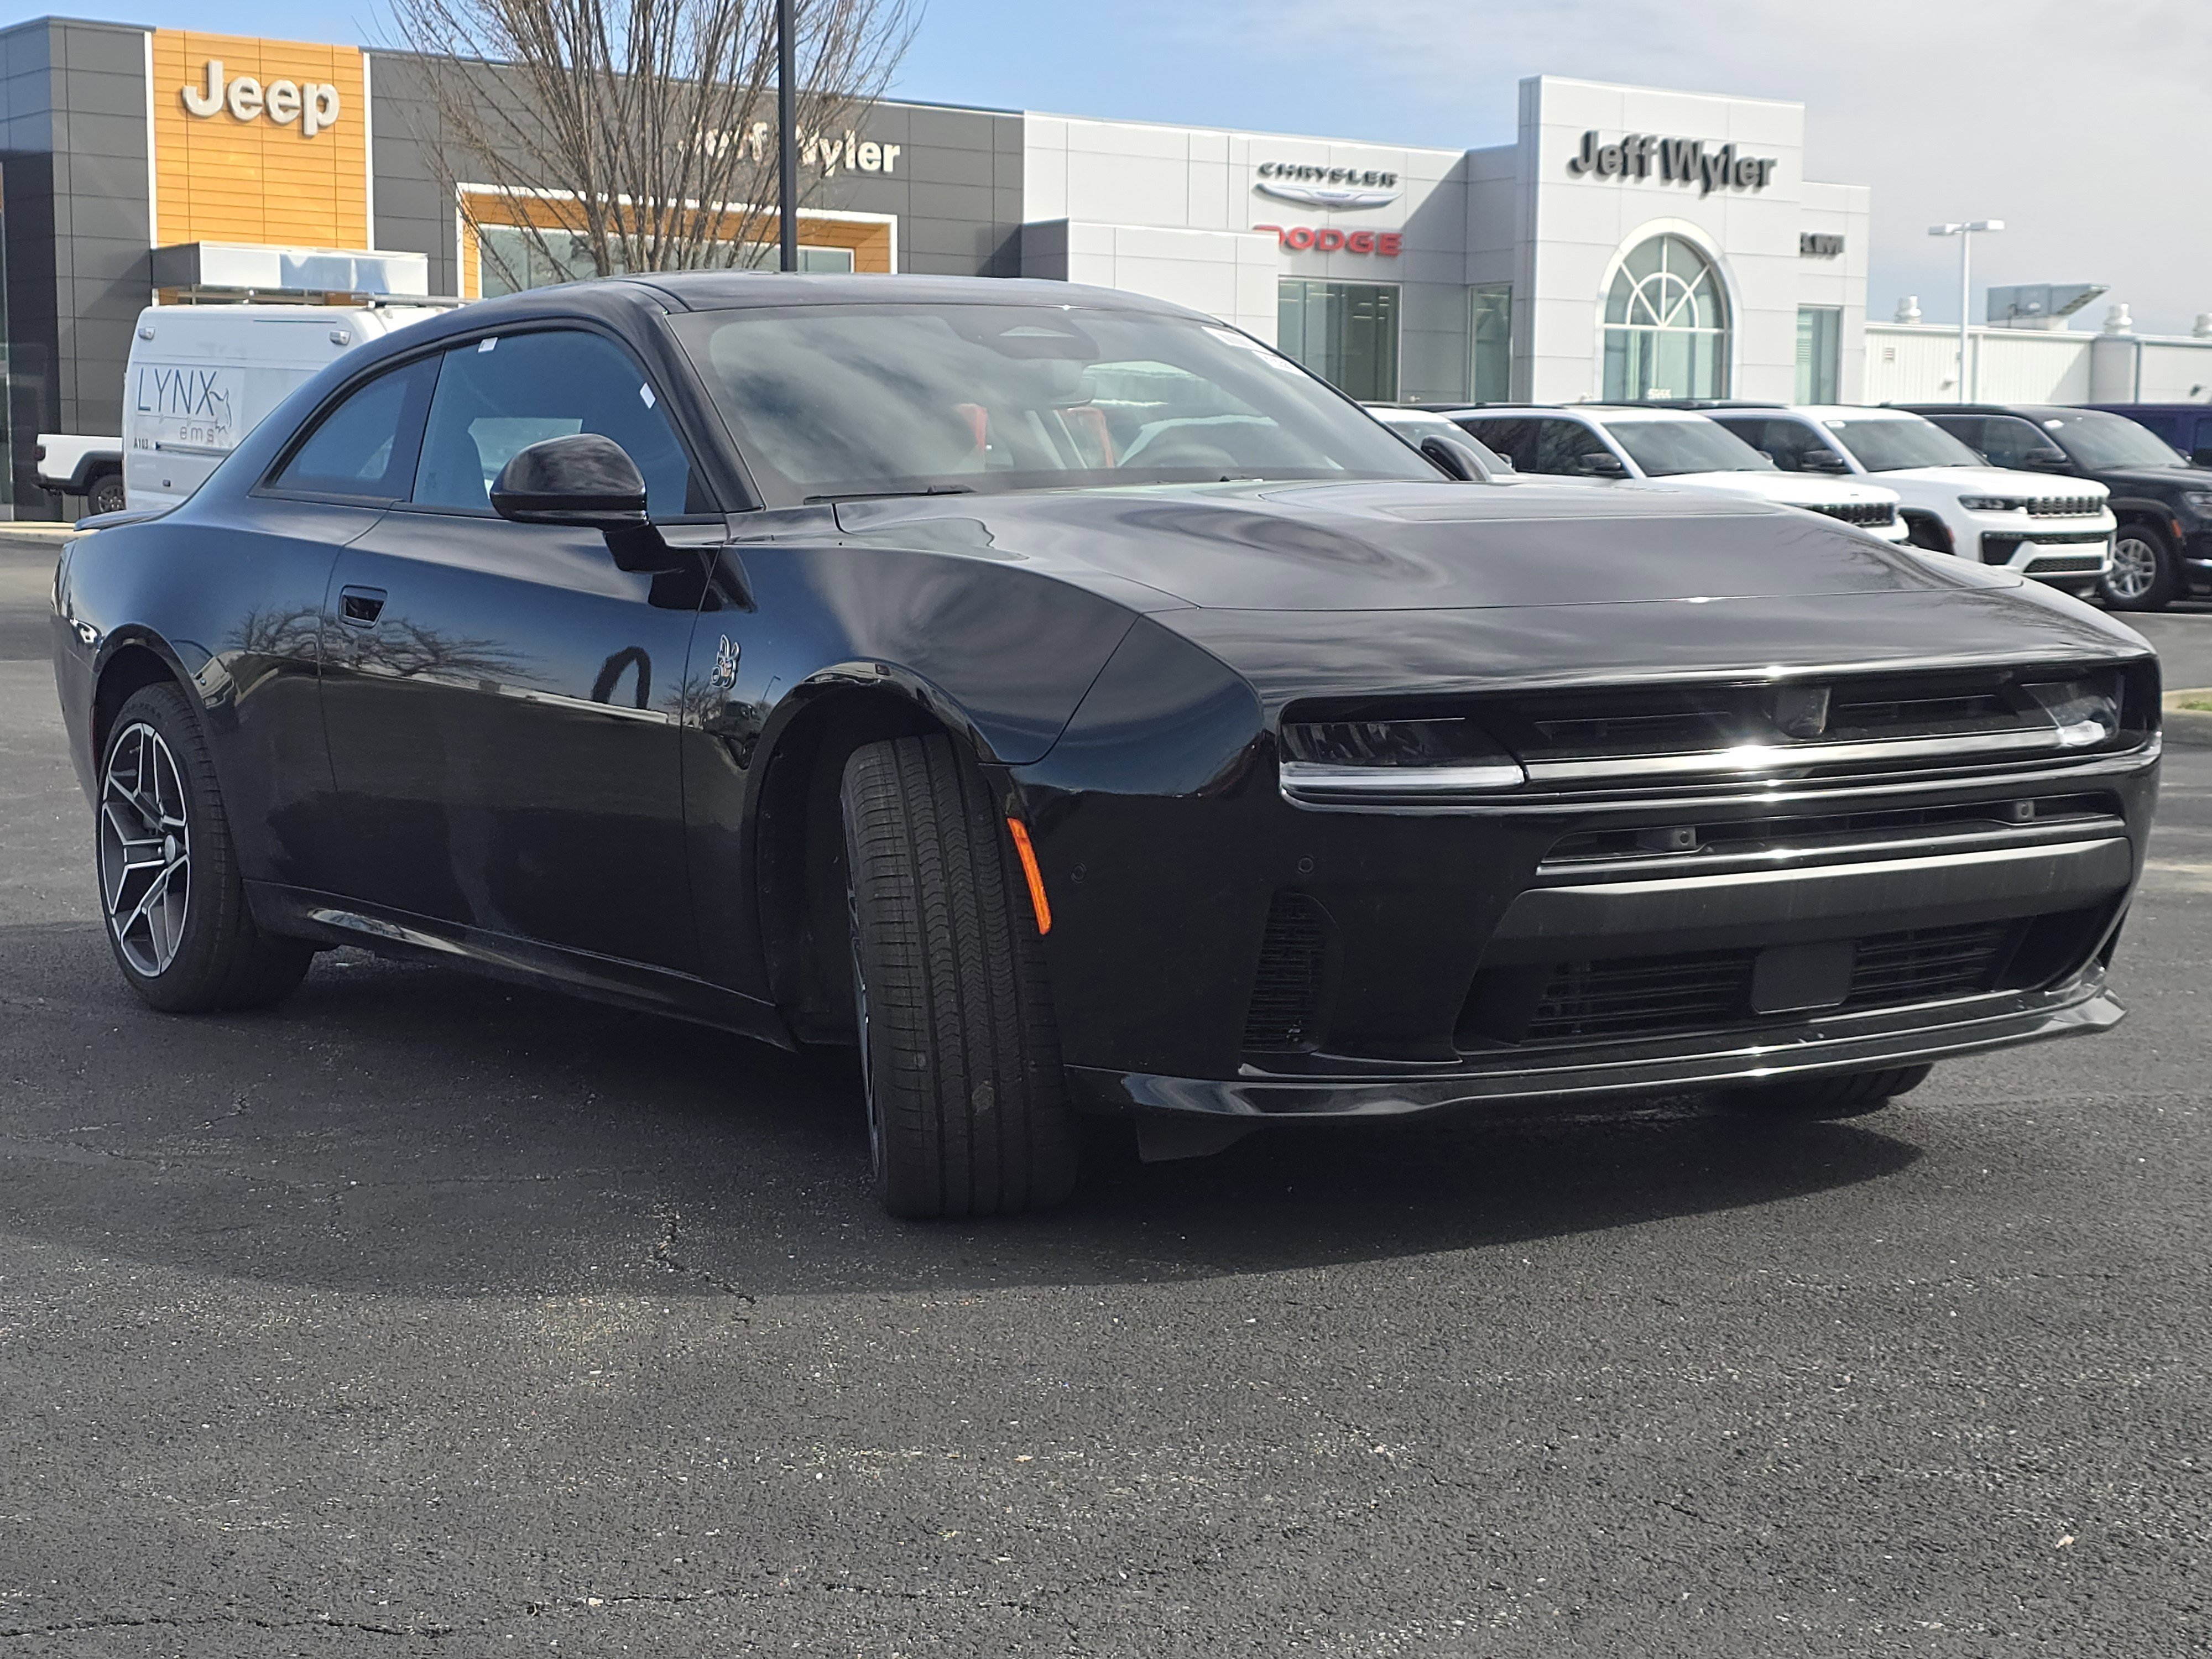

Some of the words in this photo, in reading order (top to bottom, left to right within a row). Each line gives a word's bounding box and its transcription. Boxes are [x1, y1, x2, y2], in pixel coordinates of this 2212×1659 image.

[182, 59, 340, 137] Jeep
[1258, 163, 1399, 187] CHRYSLER
[1568, 130, 1658, 180] Jeff
[1660, 137, 1778, 197] Wyler
[137, 367, 217, 416] LYNX
[179, 426, 215, 443] ems
